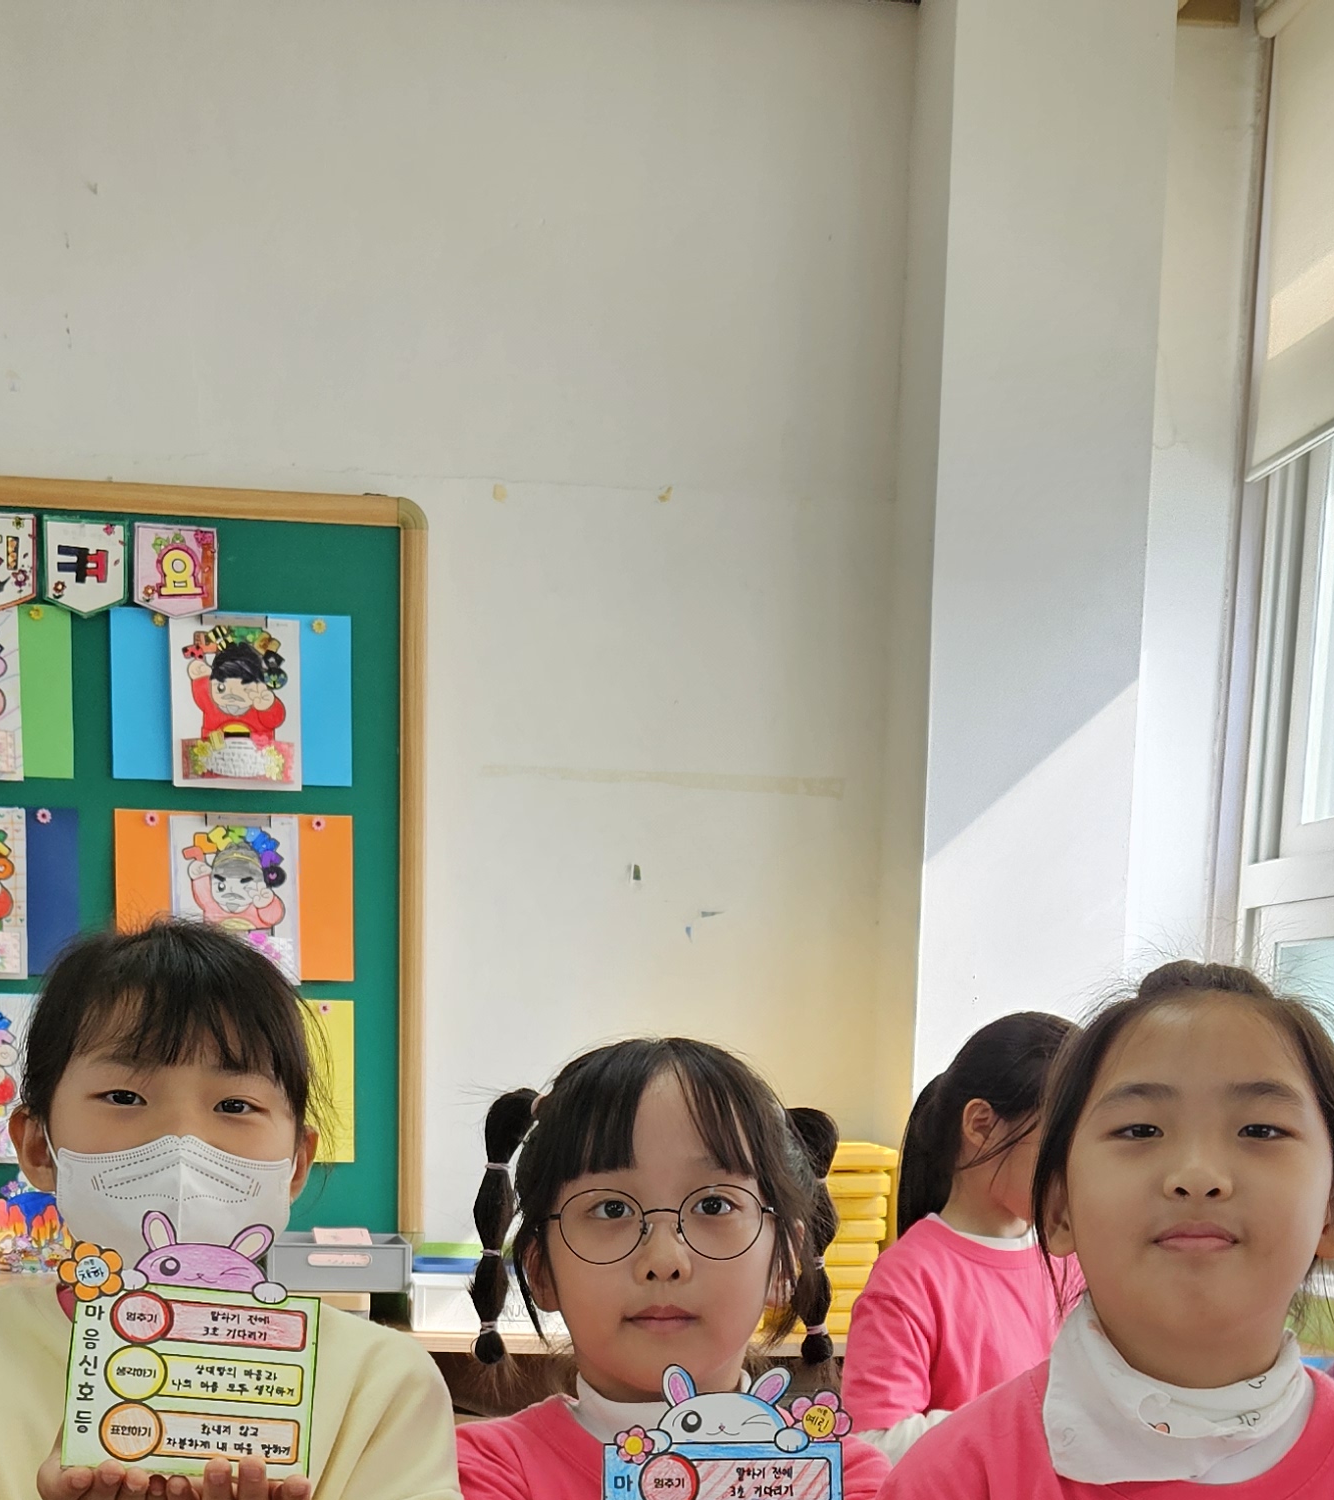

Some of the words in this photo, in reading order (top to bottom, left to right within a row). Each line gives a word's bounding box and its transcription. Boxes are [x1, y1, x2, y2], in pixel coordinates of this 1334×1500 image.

[126, 1311, 158, 1324] 멈추기
[74, 1304, 105, 1434] 마음신호등
[115, 1366, 157, 1379] 생각하기
[110, 1424, 152, 1437] 표현하기
[654, 1477, 685, 1489] 멈추기
